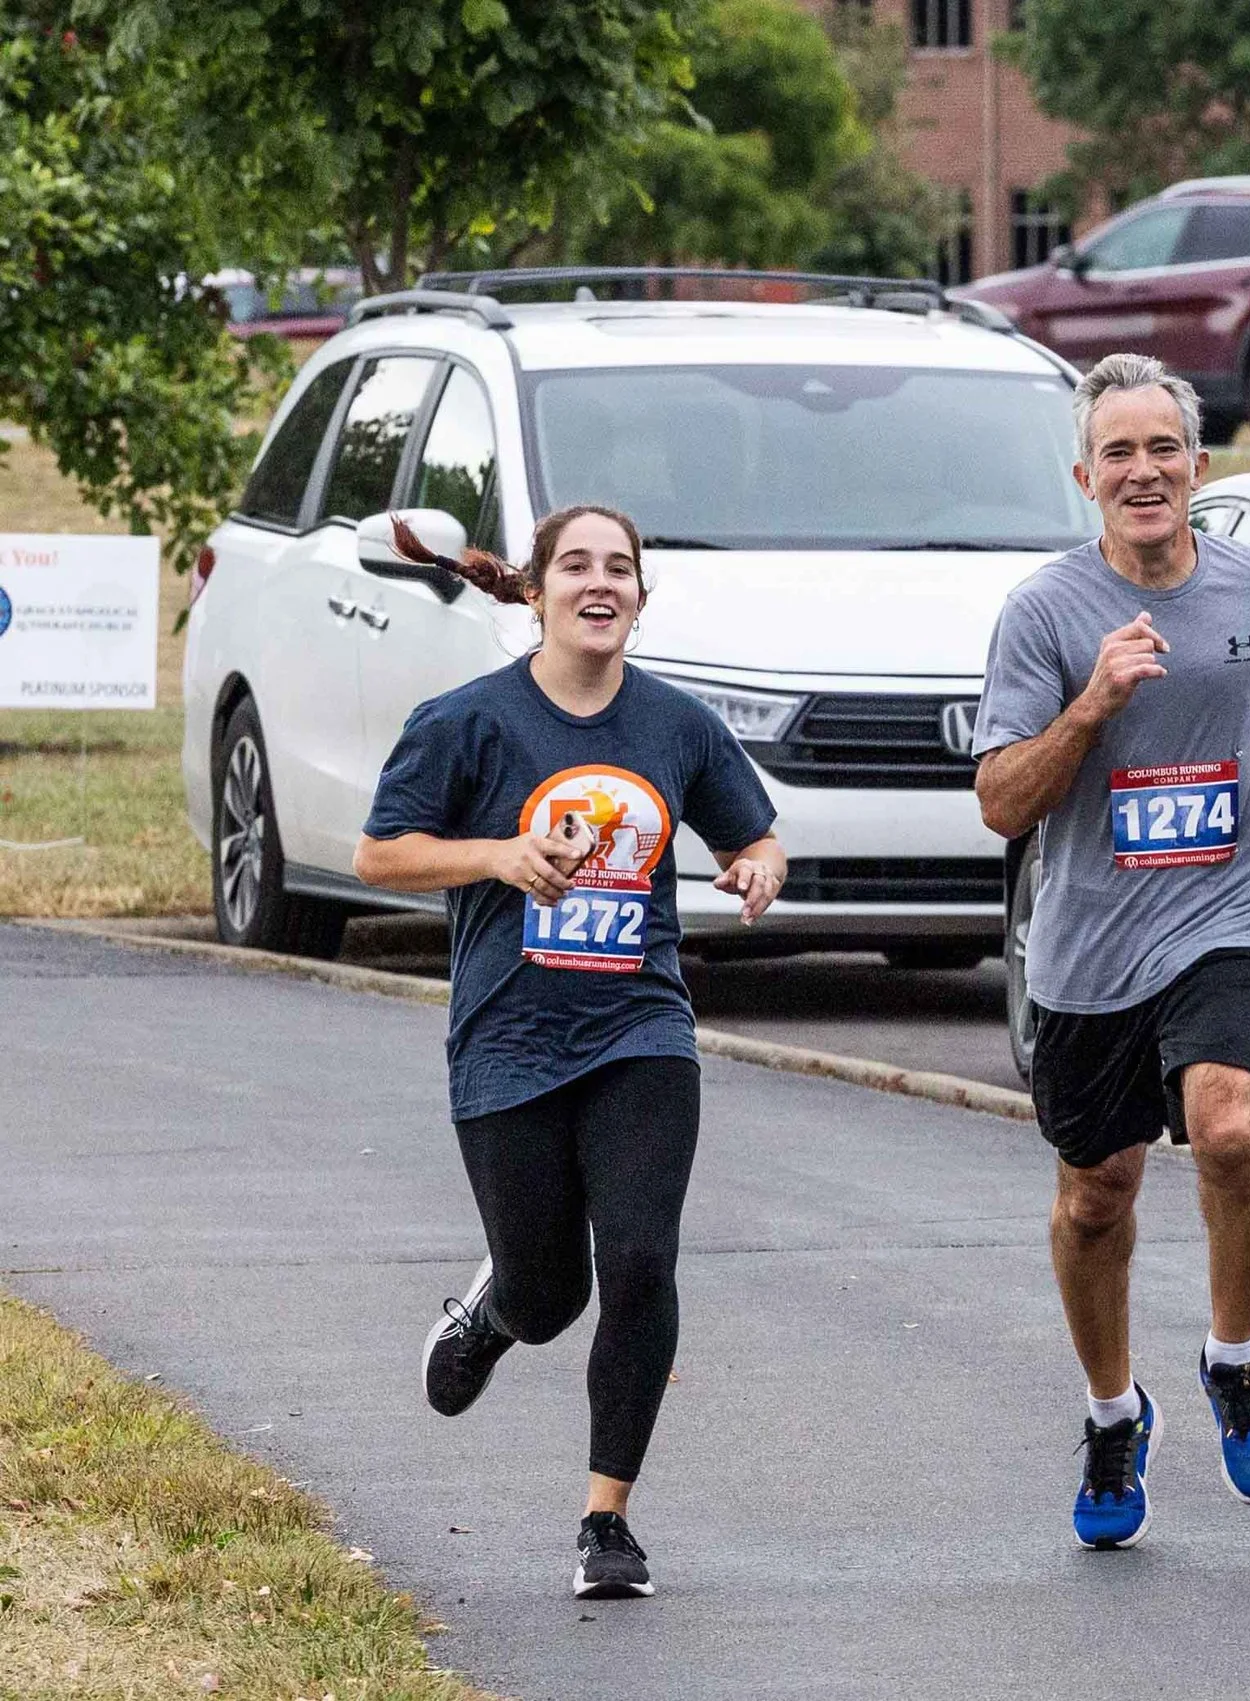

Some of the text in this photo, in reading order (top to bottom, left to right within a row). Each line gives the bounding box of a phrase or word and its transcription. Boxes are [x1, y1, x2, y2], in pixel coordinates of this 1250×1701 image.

[1127, 763, 1222, 779] COLUMBUS RUNNING
[1153, 775, 1196, 785] COMPANY
[1118, 792, 1235, 841] 1274
[1139, 850, 1231, 866] columbusrunning.com
[598, 870, 638, 881] RUNNING
[531, 897, 644, 944] 1272
[546, 956, 636, 970] columbusrunning.com
